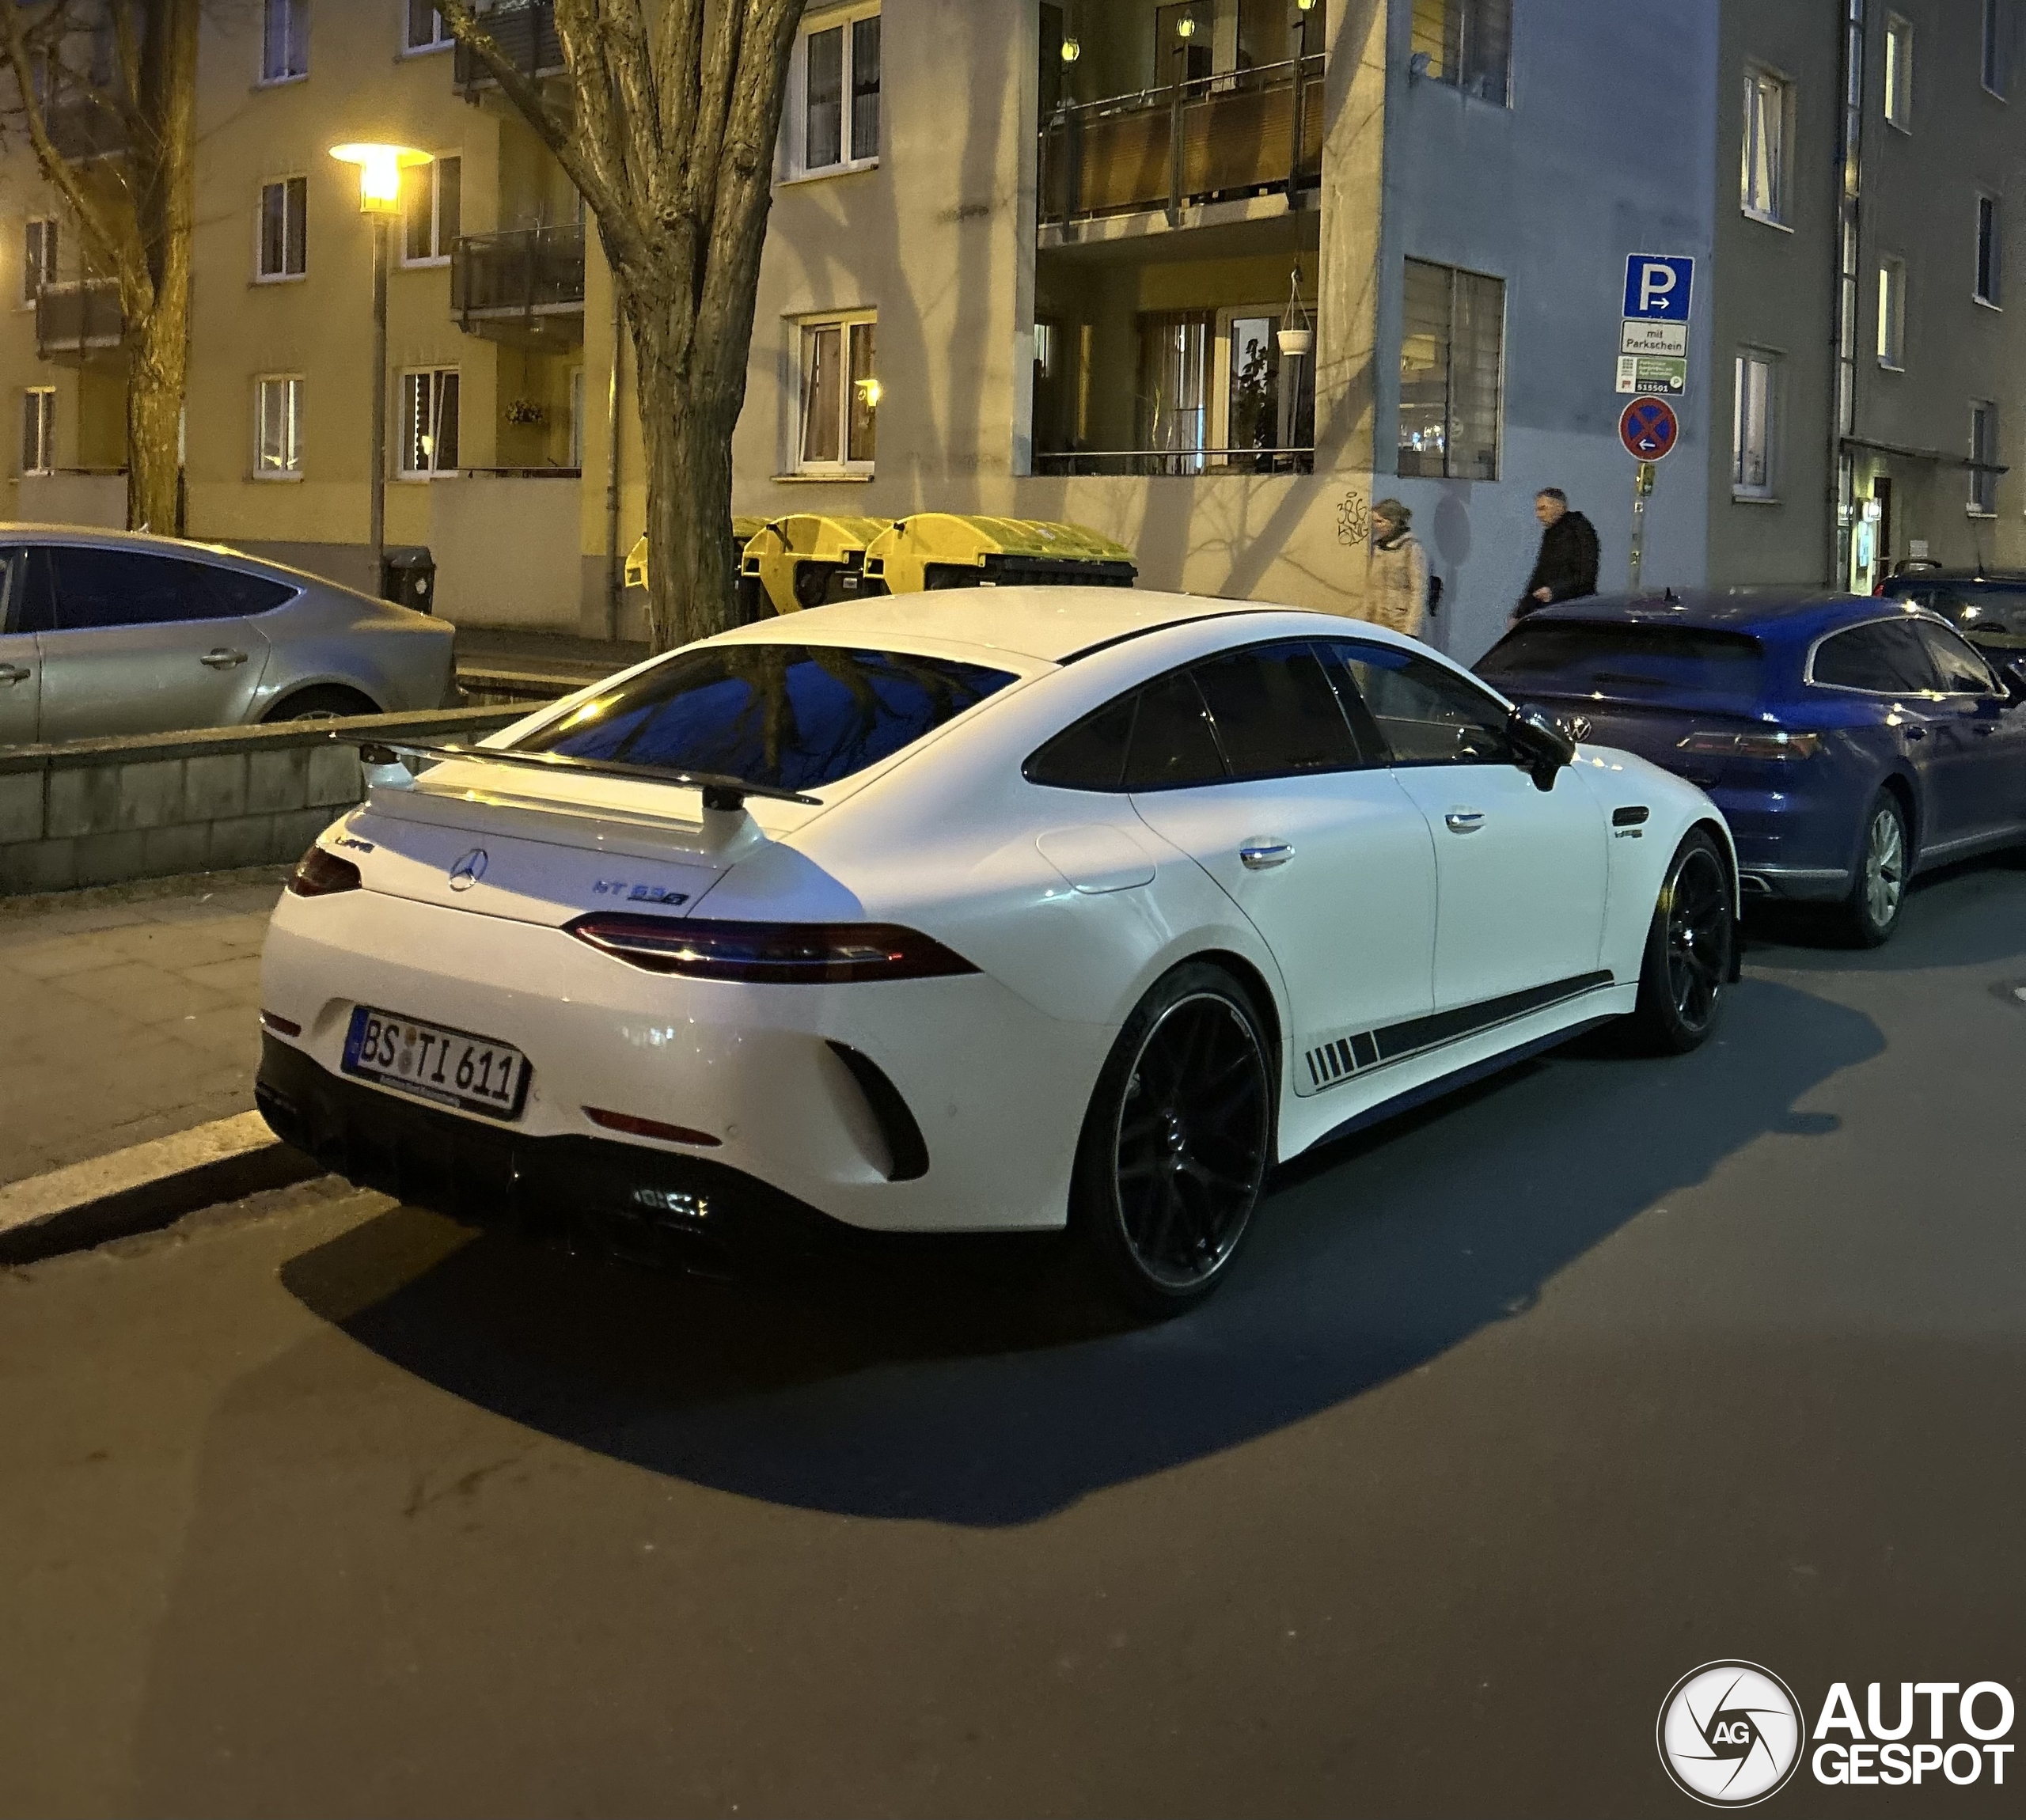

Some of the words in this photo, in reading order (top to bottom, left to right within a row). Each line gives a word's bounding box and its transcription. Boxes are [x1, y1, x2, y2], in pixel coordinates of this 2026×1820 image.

[1639, 263, 1677, 311] P
[1647, 329, 1664, 339] mit
[1626, 339, 1683, 351] Parkschein
[1637, 384, 1668, 392] 515501
[361, 1019, 400, 1067] BS
[416, 1033, 450, 1084] TI
[455, 1046, 513, 1102] 611
